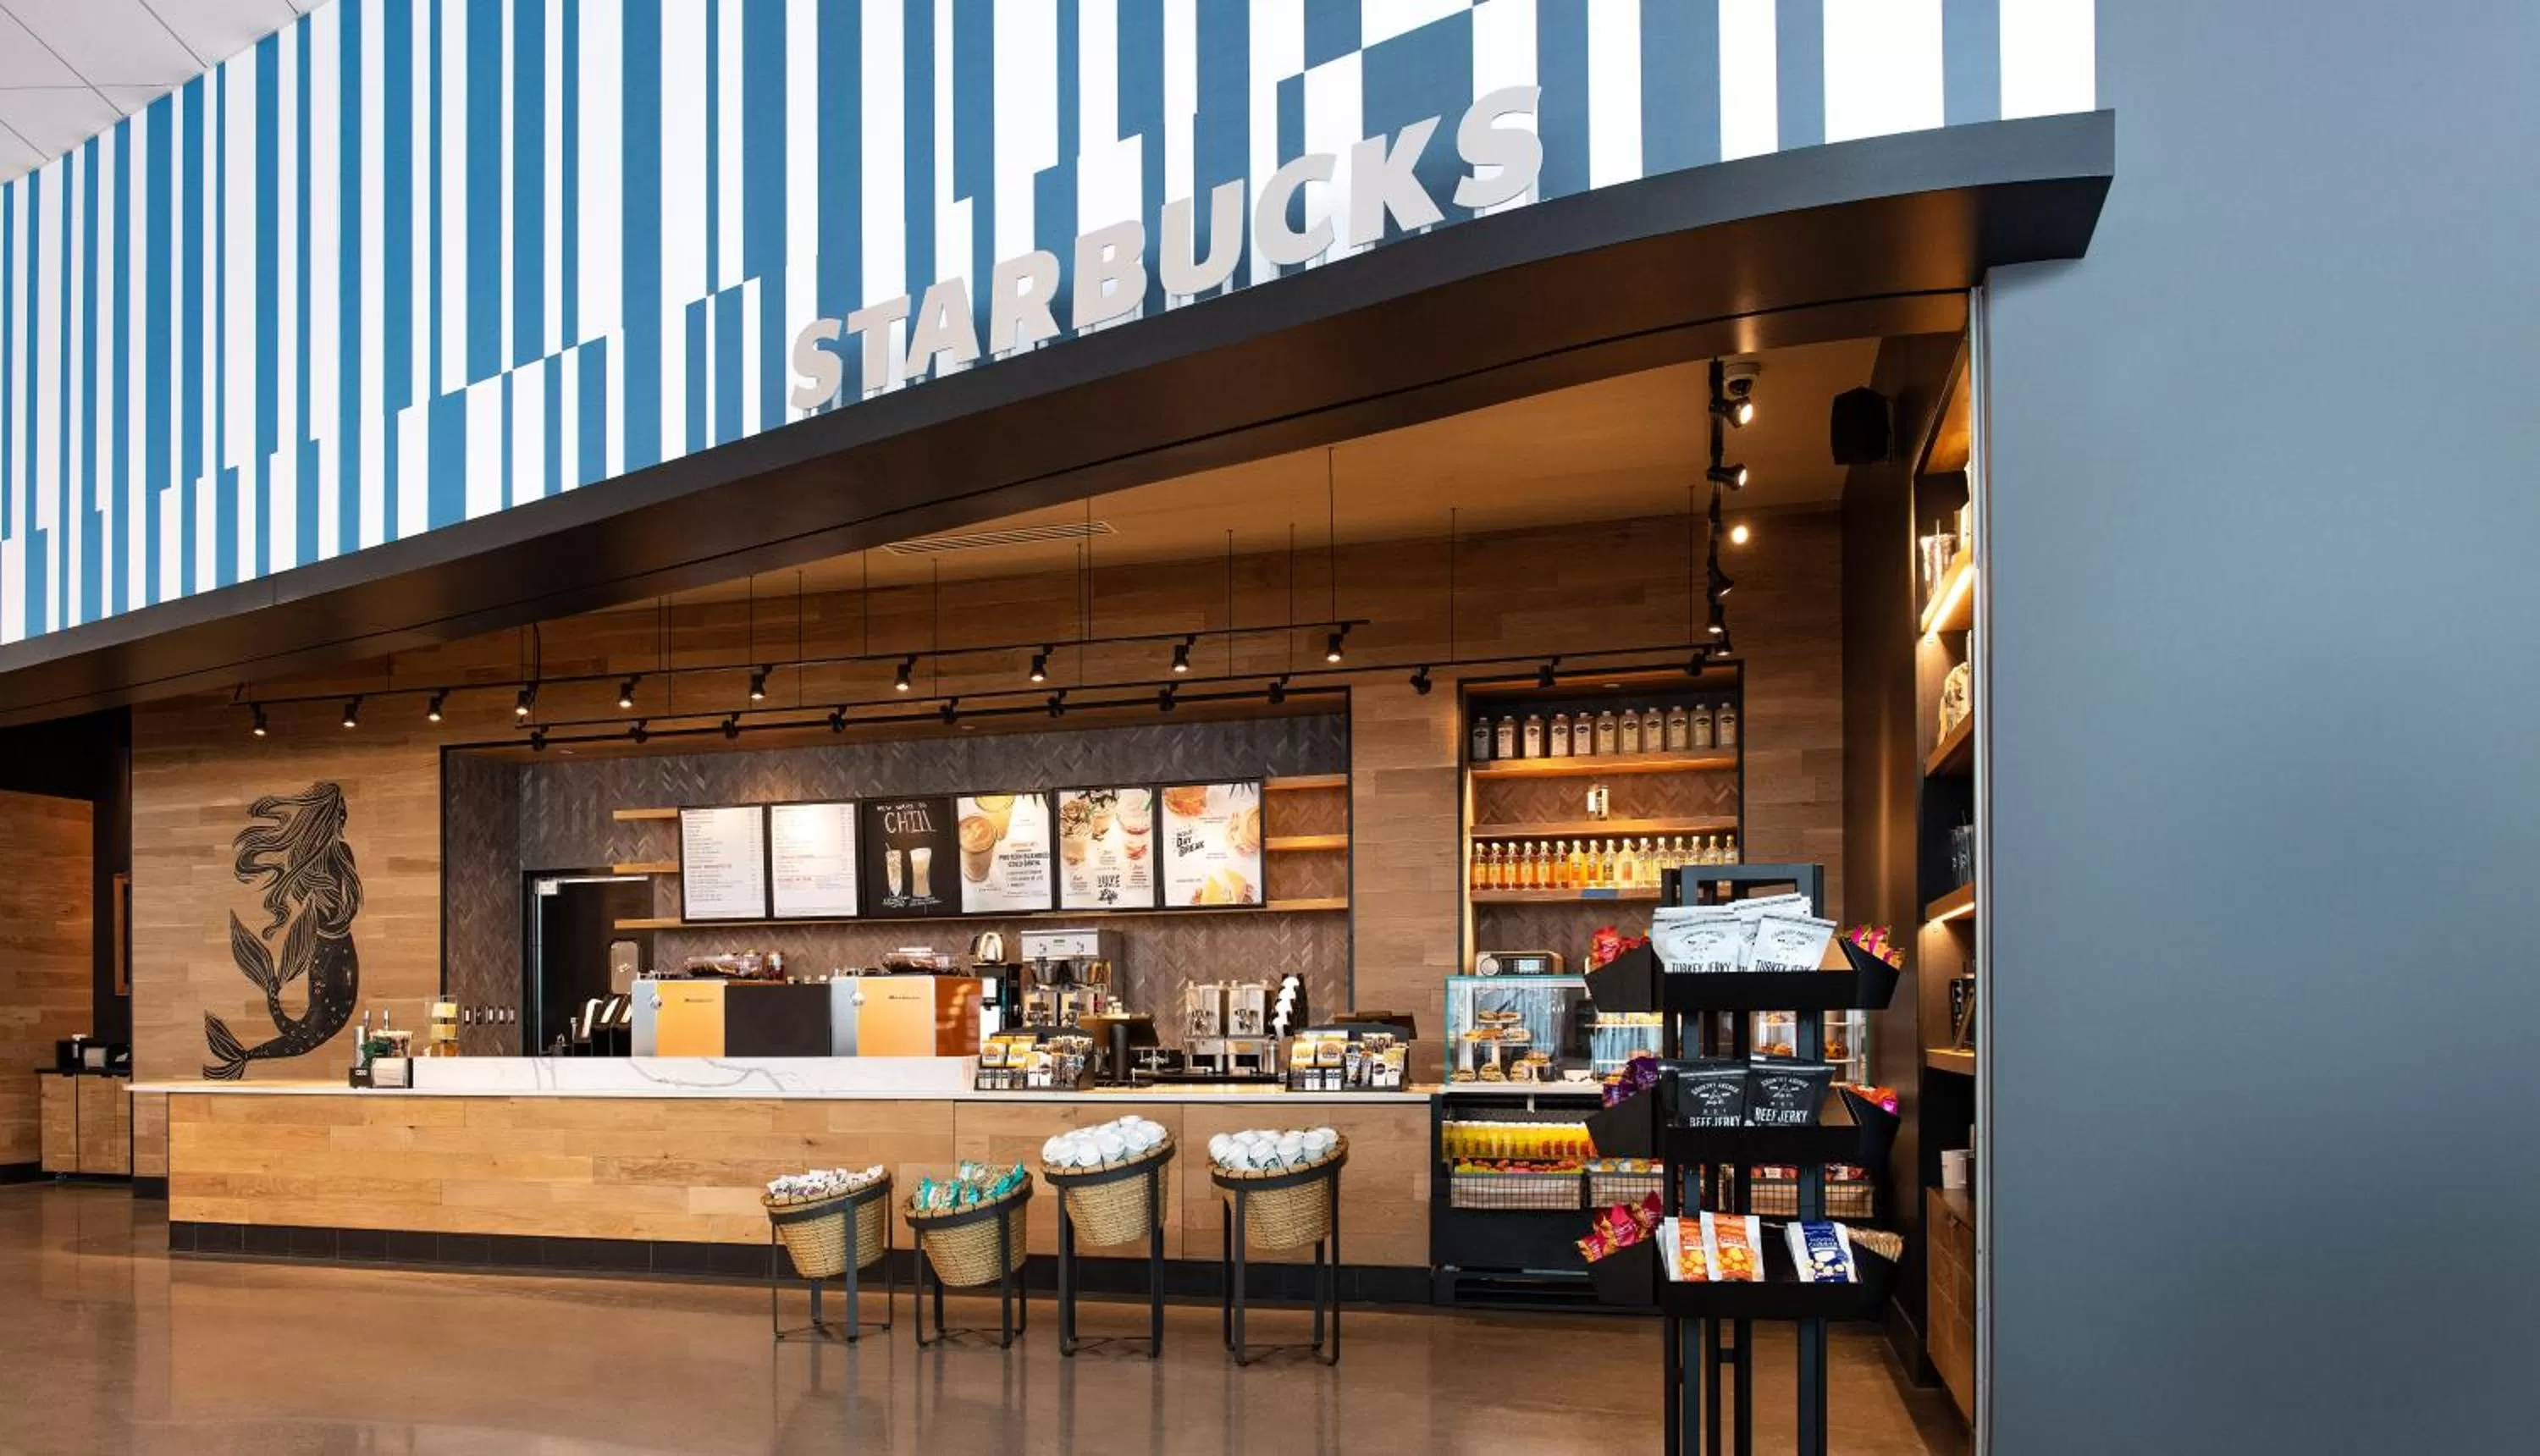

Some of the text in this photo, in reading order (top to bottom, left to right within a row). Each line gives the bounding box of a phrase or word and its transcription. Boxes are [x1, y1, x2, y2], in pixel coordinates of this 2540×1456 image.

[789, 85, 1543, 411] STARBUCKS
[885, 809, 937, 834] CHILL
[1754, 1106, 1808, 1123] BEEF JERKY
